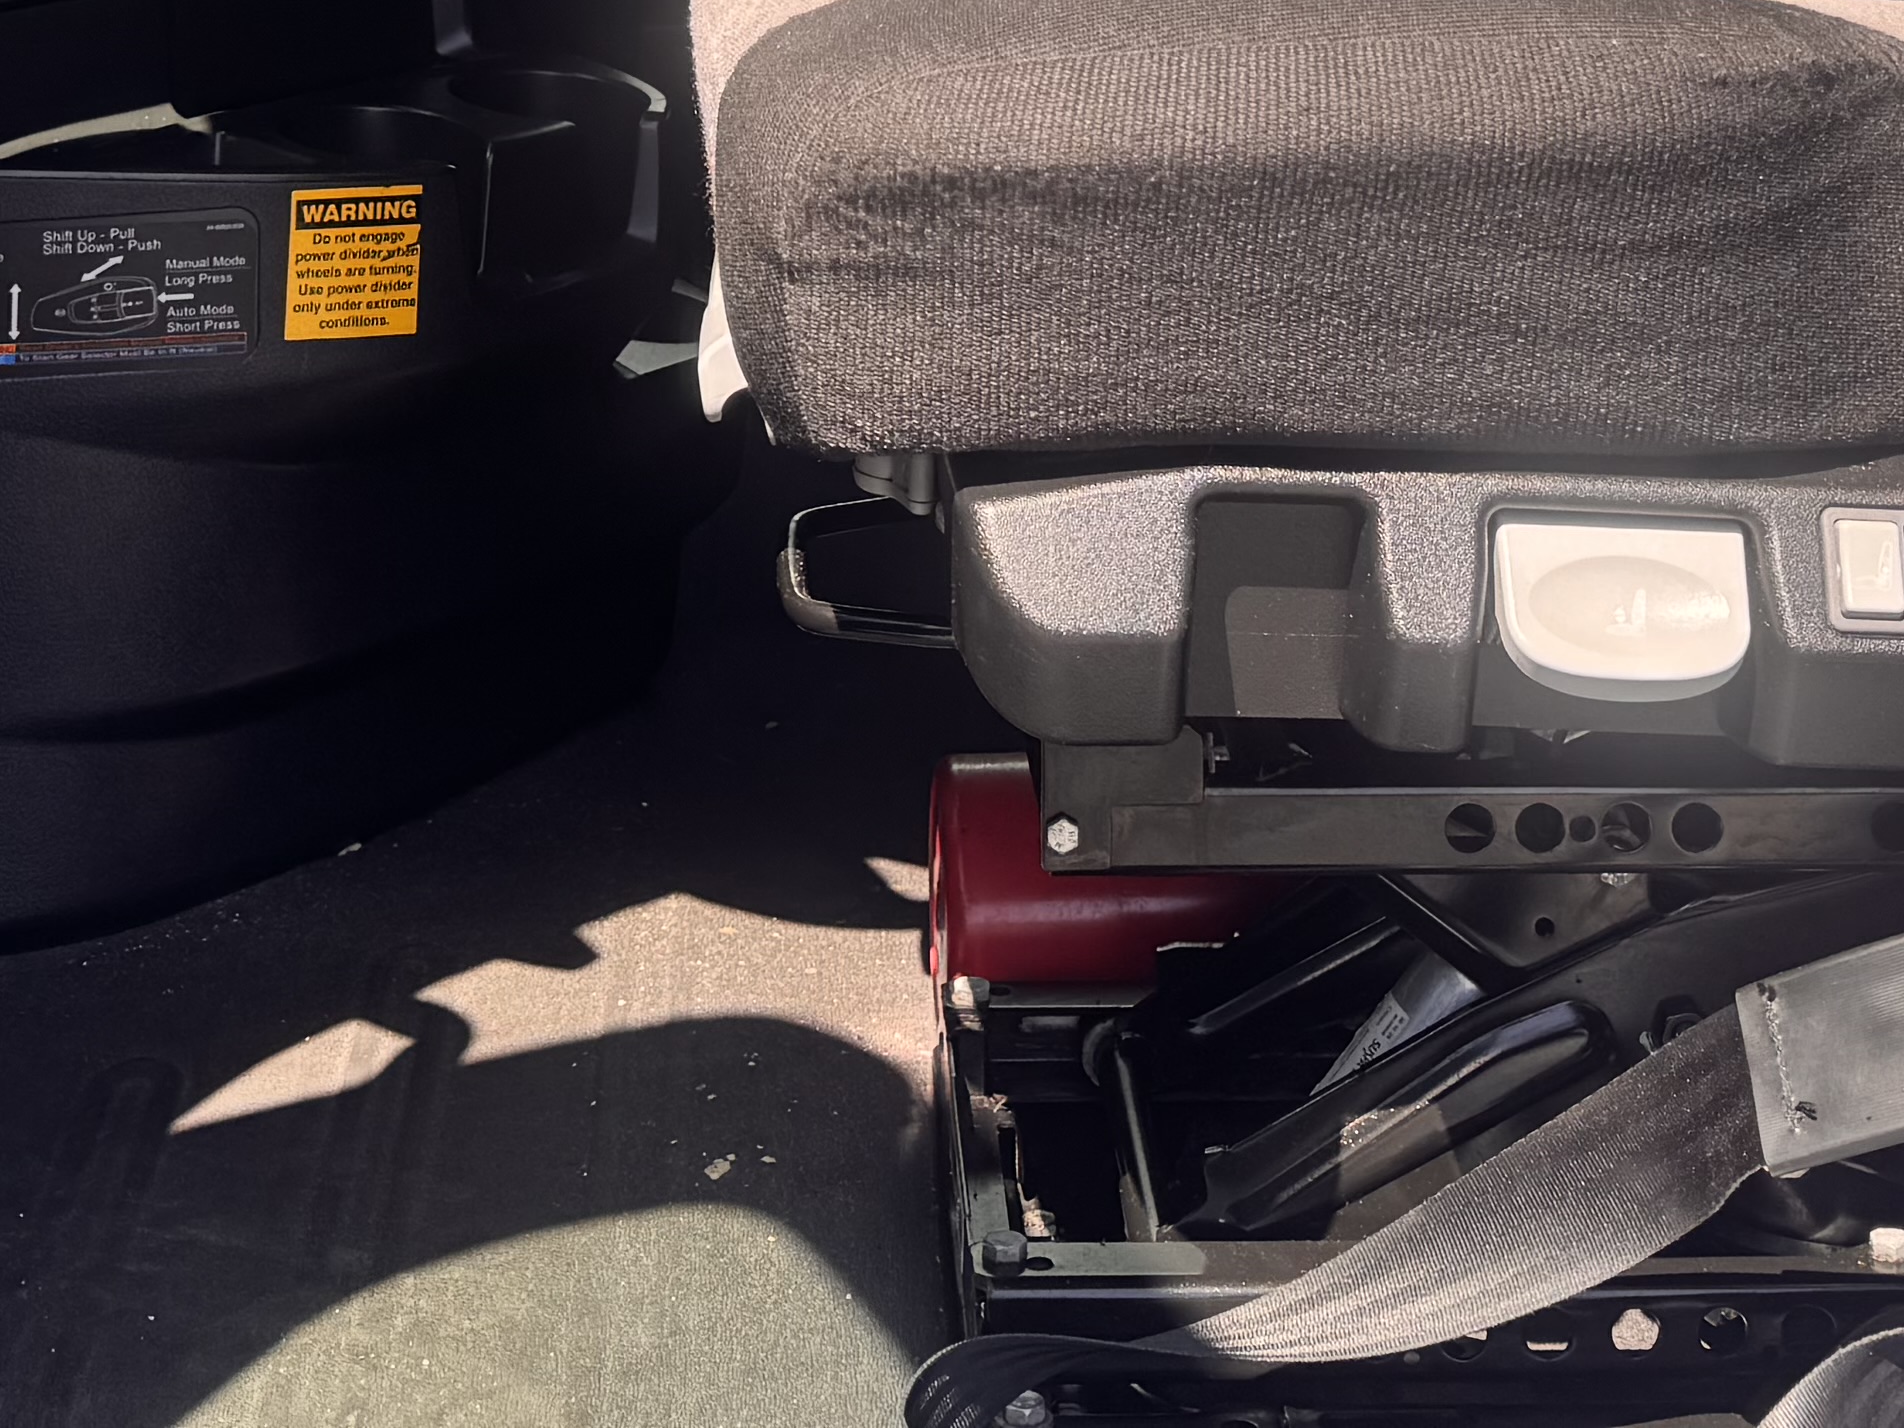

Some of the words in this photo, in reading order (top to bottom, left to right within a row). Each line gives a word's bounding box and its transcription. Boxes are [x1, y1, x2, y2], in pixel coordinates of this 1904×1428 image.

[303, 200, 417, 223] WARNING
[43, 230, 73, 242] Shift
[78, 230, 97, 244] Up
[110, 228, 135, 239] Pull
[313, 233, 331, 245] Do
[335, 232, 355, 244] not
[359, 232, 405, 245] engage
[43, 243, 73, 255] Shift
[77, 242, 114, 253] Down
[128, 240, 161, 251] Push
[165, 257, 209, 269] Manual
[213, 256, 246, 267] Mode
[295, 251, 335, 265] power
[339, 248, 383, 260] divider
[296, 267, 341, 278] wheels
[346, 267, 365, 276] are
[165, 275, 195, 288] Long
[199, 273, 232, 284] Press
[299, 284, 323, 295] Use
[328, 284, 367, 298] power
[371, 280, 413, 292] divider
[167, 306, 196, 317] Auto
[200, 304, 234, 315] Mode
[293, 301, 320, 314] only
[325, 299, 363, 311] under
[366, 297, 416, 308] extreme
[167, 322, 200, 333] Short
[204, 319, 240, 330] Press
[319, 316, 389, 329] conditions.
